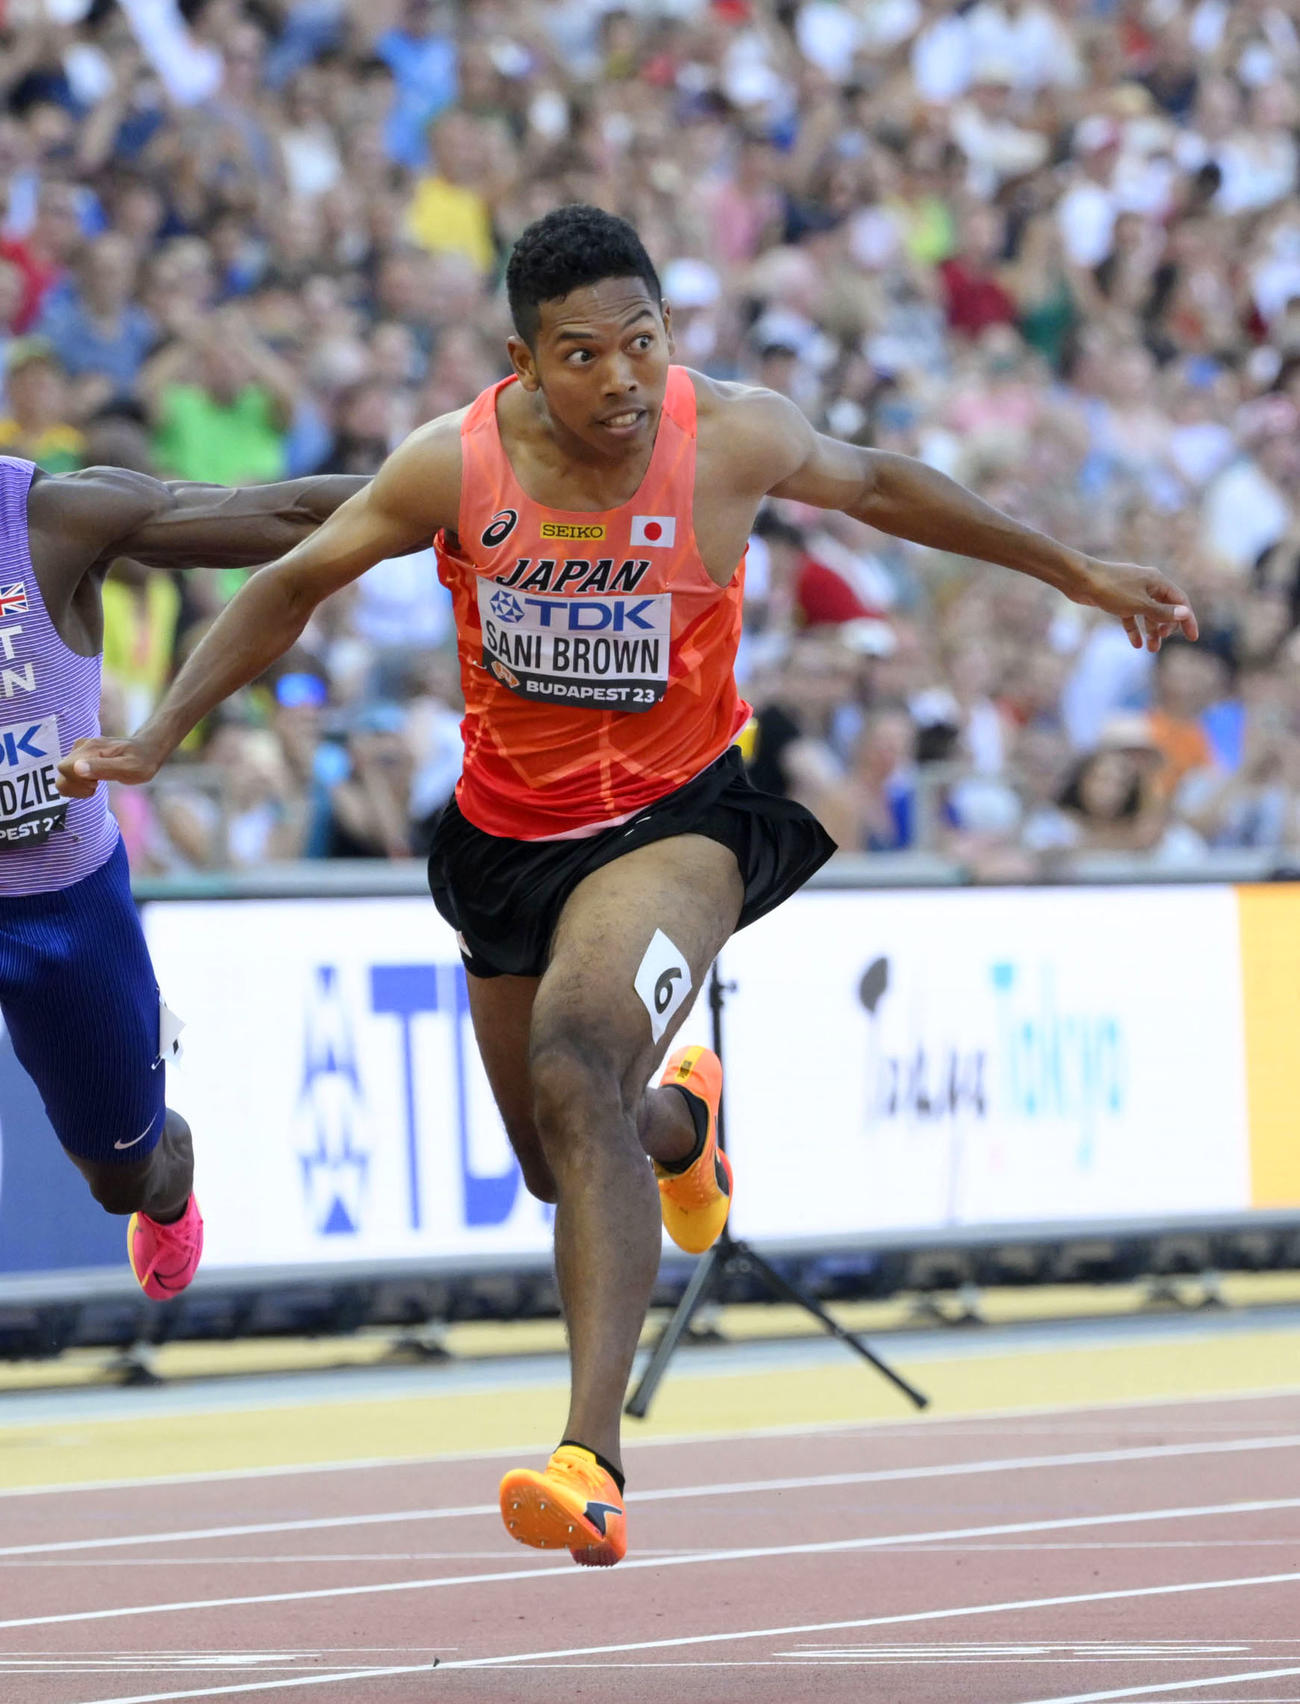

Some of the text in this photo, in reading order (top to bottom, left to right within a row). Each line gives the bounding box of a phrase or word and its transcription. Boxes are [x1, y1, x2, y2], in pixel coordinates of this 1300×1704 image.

[542, 524, 604, 539] SEIKO
[495, 559, 652, 593] JAPAN
[524, 598, 657, 632] TDK
[485, 619, 660, 675] SANI BROWN
[525, 680, 656, 703] BUDAPEST 23
[654, 966, 683, 1015] 6
[369, 963, 557, 1231] TD
